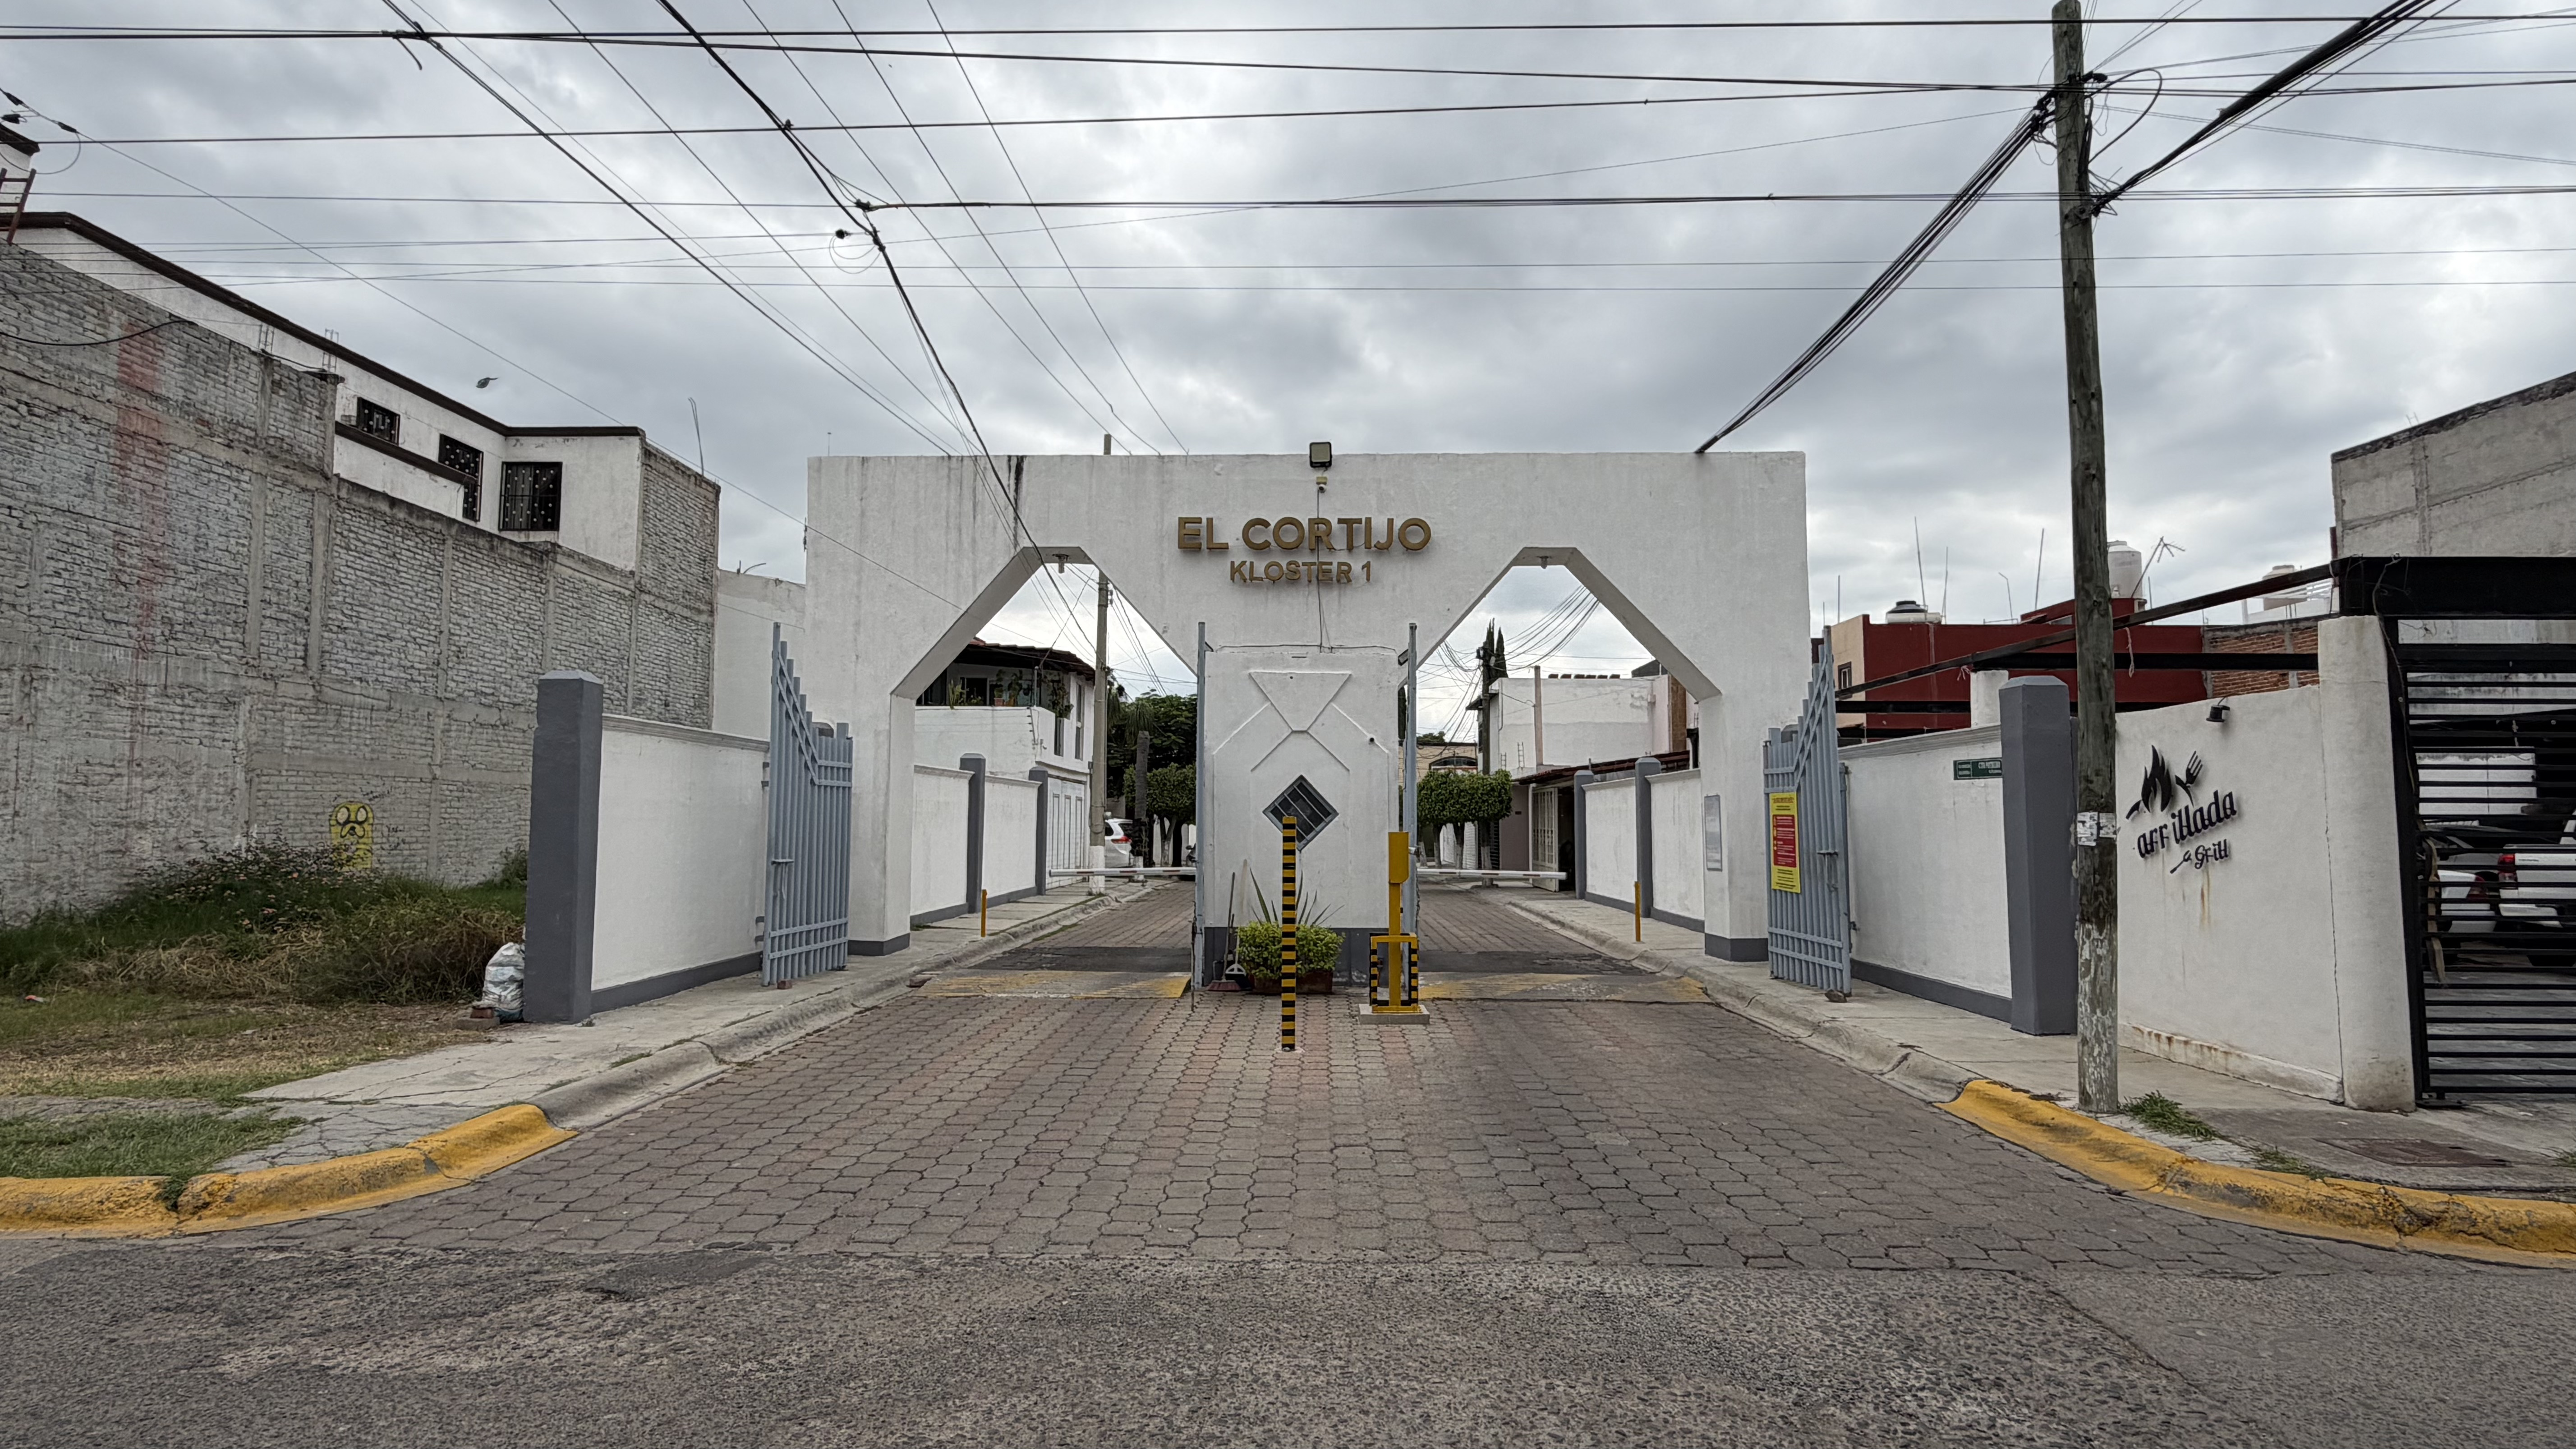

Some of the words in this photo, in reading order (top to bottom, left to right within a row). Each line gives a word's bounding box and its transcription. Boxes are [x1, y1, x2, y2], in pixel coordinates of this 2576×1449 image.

[1178, 517, 1229, 550] EL
[1242, 517, 1431, 551] CORTIJO
[1230, 561, 1352, 583] KLOSTER
[1361, 561, 1371, 582] 1
[2194, 838, 2229, 869] Grill
